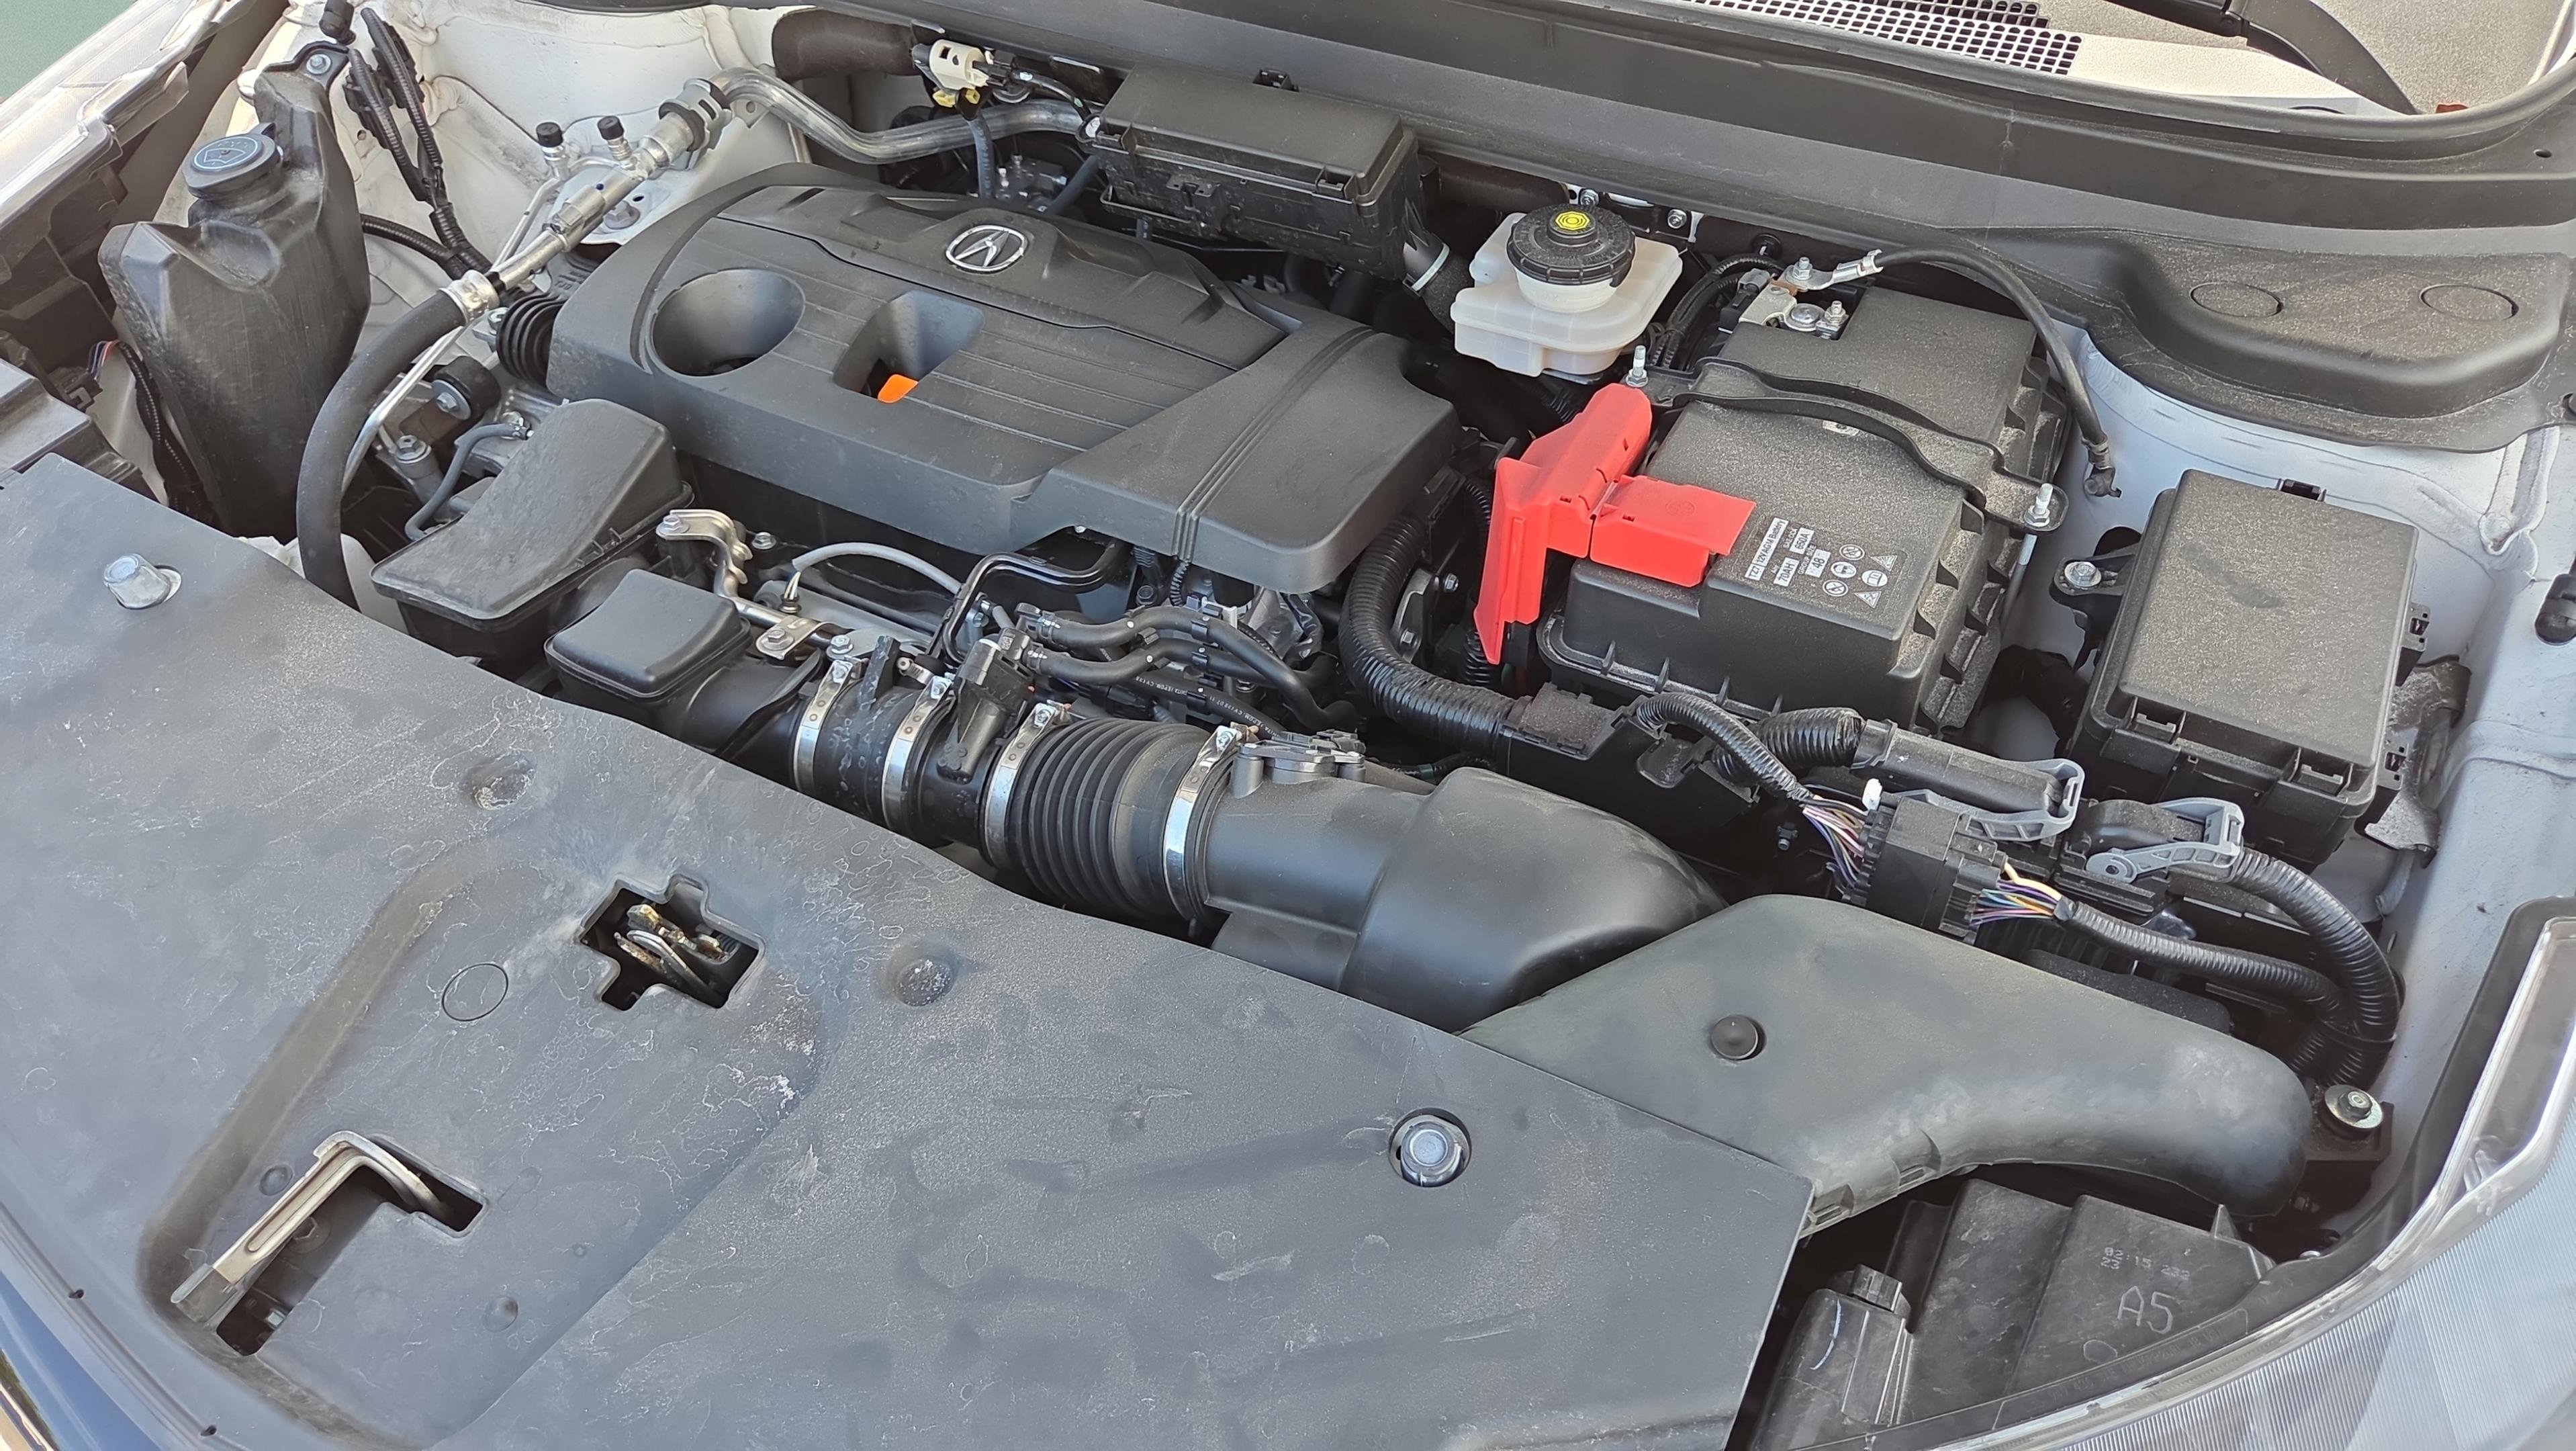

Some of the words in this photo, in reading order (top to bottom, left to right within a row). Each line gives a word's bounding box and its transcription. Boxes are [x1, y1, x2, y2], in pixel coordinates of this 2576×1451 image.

[1761, 538, 1774, 554] AGM
[1769, 520, 1786, 539] Battery
[1794, 533, 1810, 549] 650A
[1797, 556, 1810, 574] GROUP
[1806, 544, 1816, 556] SIZE
[1811, 557, 1825, 568] 48
[1778, 562, 1795, 582] 70AH
[2117, 1286, 2176, 1334] A5
